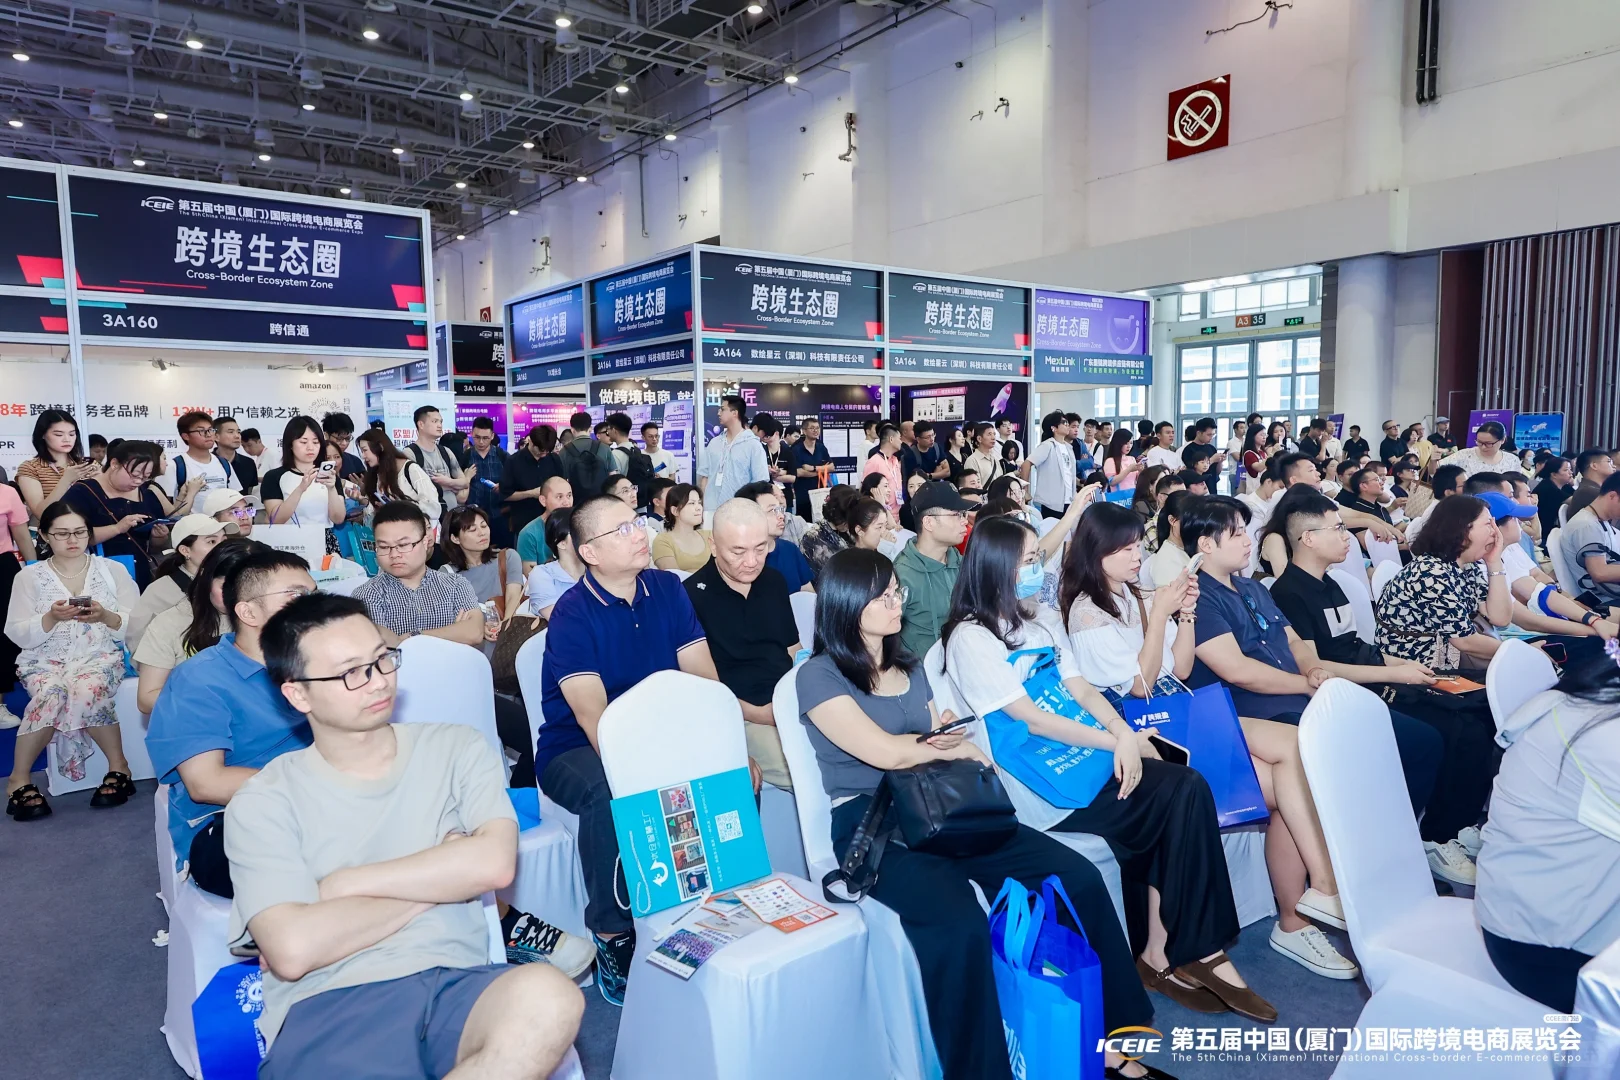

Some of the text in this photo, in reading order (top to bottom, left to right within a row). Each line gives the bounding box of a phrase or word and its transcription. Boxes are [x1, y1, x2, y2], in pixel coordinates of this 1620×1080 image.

[140, 197, 175, 211] ICEIE
[174, 226, 341, 278] 跨境生态圈
[186, 269, 334, 289] Cross-Border Ecosystem Zone
[614, 287, 666, 324] 跨境生态圈
[751, 283, 839, 318] 跨境生态圈
[102, 314, 158, 329] 3A160
[756, 314, 792, 323] Cross-Border
[793, 317, 821, 326] Ecosystem
[924, 300, 994, 331] 跨境生态圈
[1237, 314, 1264, 326] A3 35
[269, 322, 310, 337] 跨信通
[528, 311, 567, 342] 跨境生态圈
[928, 327, 957, 336] Cross-Border
[957, 329, 979, 338] Ecosystem
[1036, 313, 1089, 338] 跨境生态圈
[713, 348, 742, 358] 3A164
[597, 361, 612, 370] 3A164
[894, 356, 917, 366] 3A164
[1045, 356, 1075, 366] MexLink
[598, 388, 671, 405] 做跨境电商
[217, 405, 300, 419] 用户信赖之选
